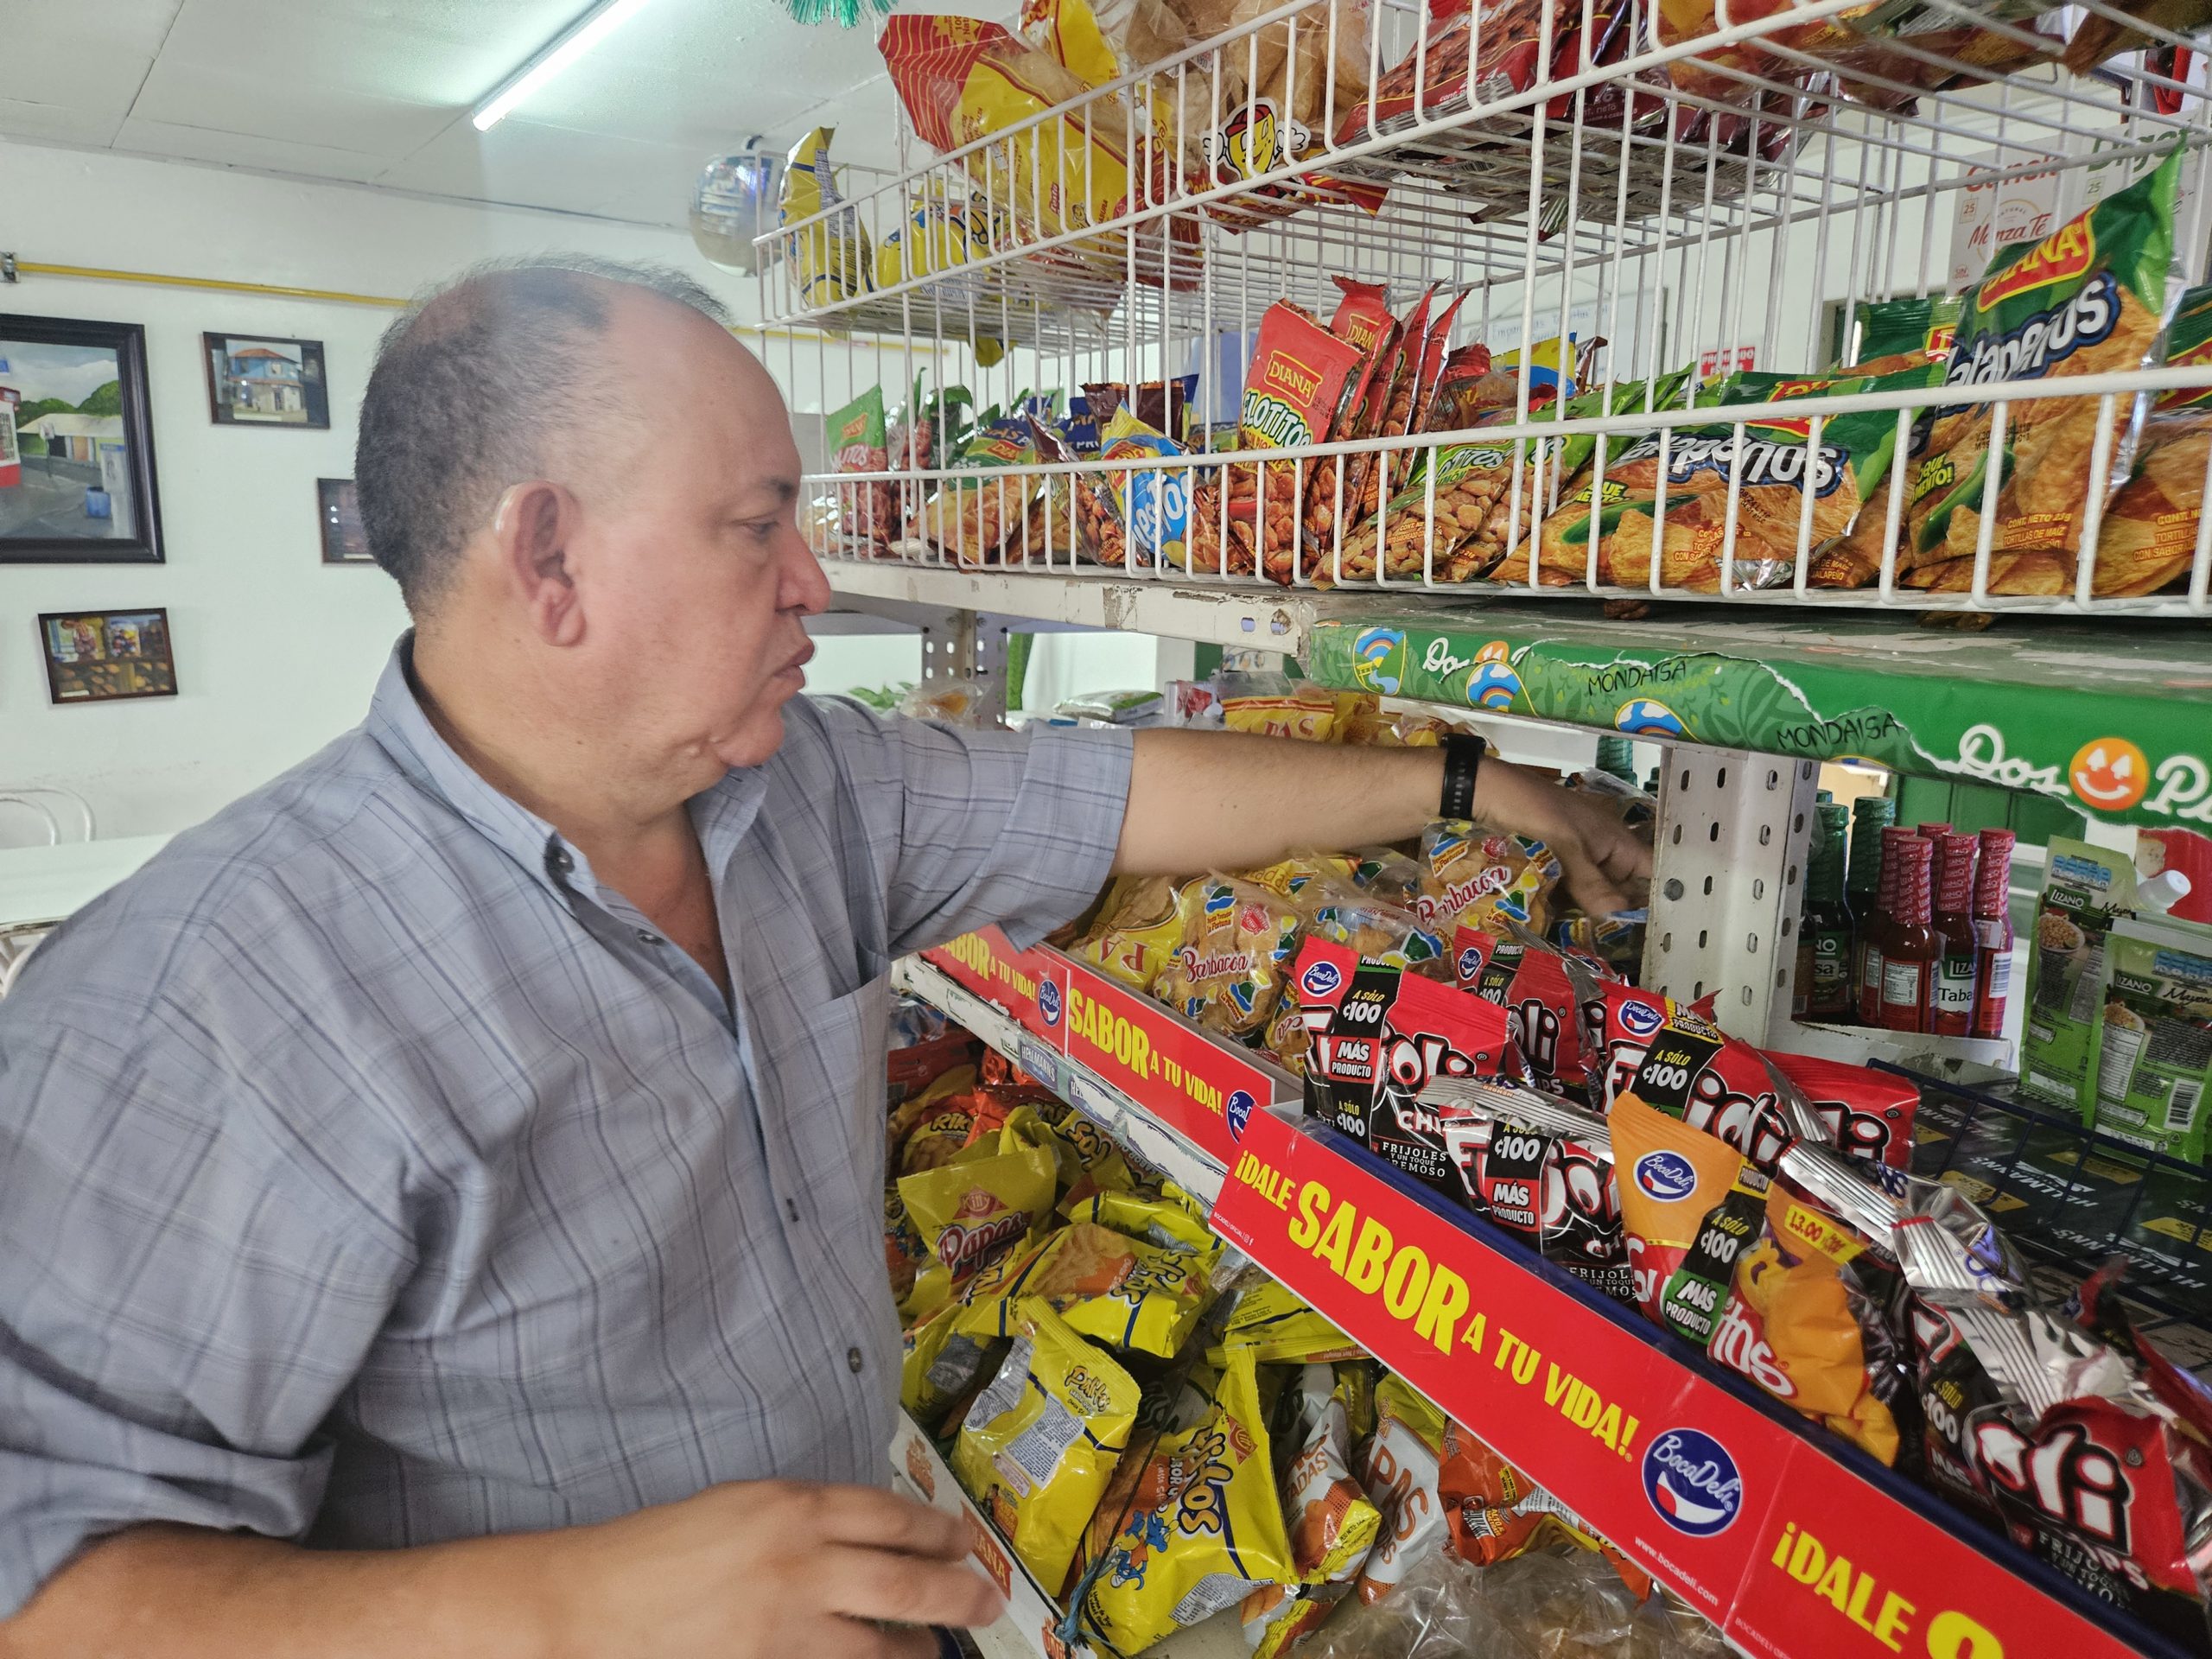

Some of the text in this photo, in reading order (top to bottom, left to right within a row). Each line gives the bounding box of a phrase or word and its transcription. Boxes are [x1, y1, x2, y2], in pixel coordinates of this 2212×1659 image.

[1963, 203, 1976, 214] 25
[1268, 360, 1312, 397] DIANA
[2028, 514, 2051, 524] NETO
[2003, 531, 2032, 546] TORTILLAS
[2033, 529, 2045, 539] DE
[1950, 724, 2071, 796] Dos
[1417, 867, 1509, 923] Brbacoa
[2050, 888, 2085, 910] LIZANO
[1182, 950, 1249, 983] Barbacoa
[1307, 965, 1339, 988] BocaDeli
[1949, 960, 1975, 977] LIZA
[989, 956, 996, 976] A
[998, 960, 1011, 984] TU
[1012, 969, 1037, 1002] VIDA!
[2117, 974, 2153, 995] LIZANO
[1352, 990, 1385, 1003] A SÓLO
[1938, 987, 1974, 1002] Taba
[1069, 988, 1224, 1116] SABOR A TU VIDA!
[1337, 1040, 1370, 1062] MÁS
[1654, 1049, 1691, 1067] A SÓLO
[1332, 1062, 1372, 1078] PRODUCTO
[1344, 1100, 1360, 1116] SÓLO
[1382, 1141, 1447, 1162] FRIJOLES
[1396, 1153, 1408, 1162] UN
[1409, 1156, 1435, 1167] TOQUE
[1644, 1154, 1694, 1191] BocaDeli
[1738, 1166, 1770, 1192] PRODUCTO
[1493, 1182, 1529, 1206] MÁS
[1492, 1205, 1535, 1225] PRODUCTO
[1712, 1213, 1750, 1236] A SÓLO
[938, 1211, 1028, 1276] Papas
[1234, 1149, 1640, 1457] ¡DALE SABOR A TU VIDA!
[1676, 1279, 1718, 1313] MÁS
[1666, 1301, 1712, 1336] PRODUCTO
[1652, 1434, 1740, 1504] BocaDeli
[1635, 1536, 1719, 1606] www.bocadeli.com
[1771, 1522, 1916, 1654] ¡DALE
